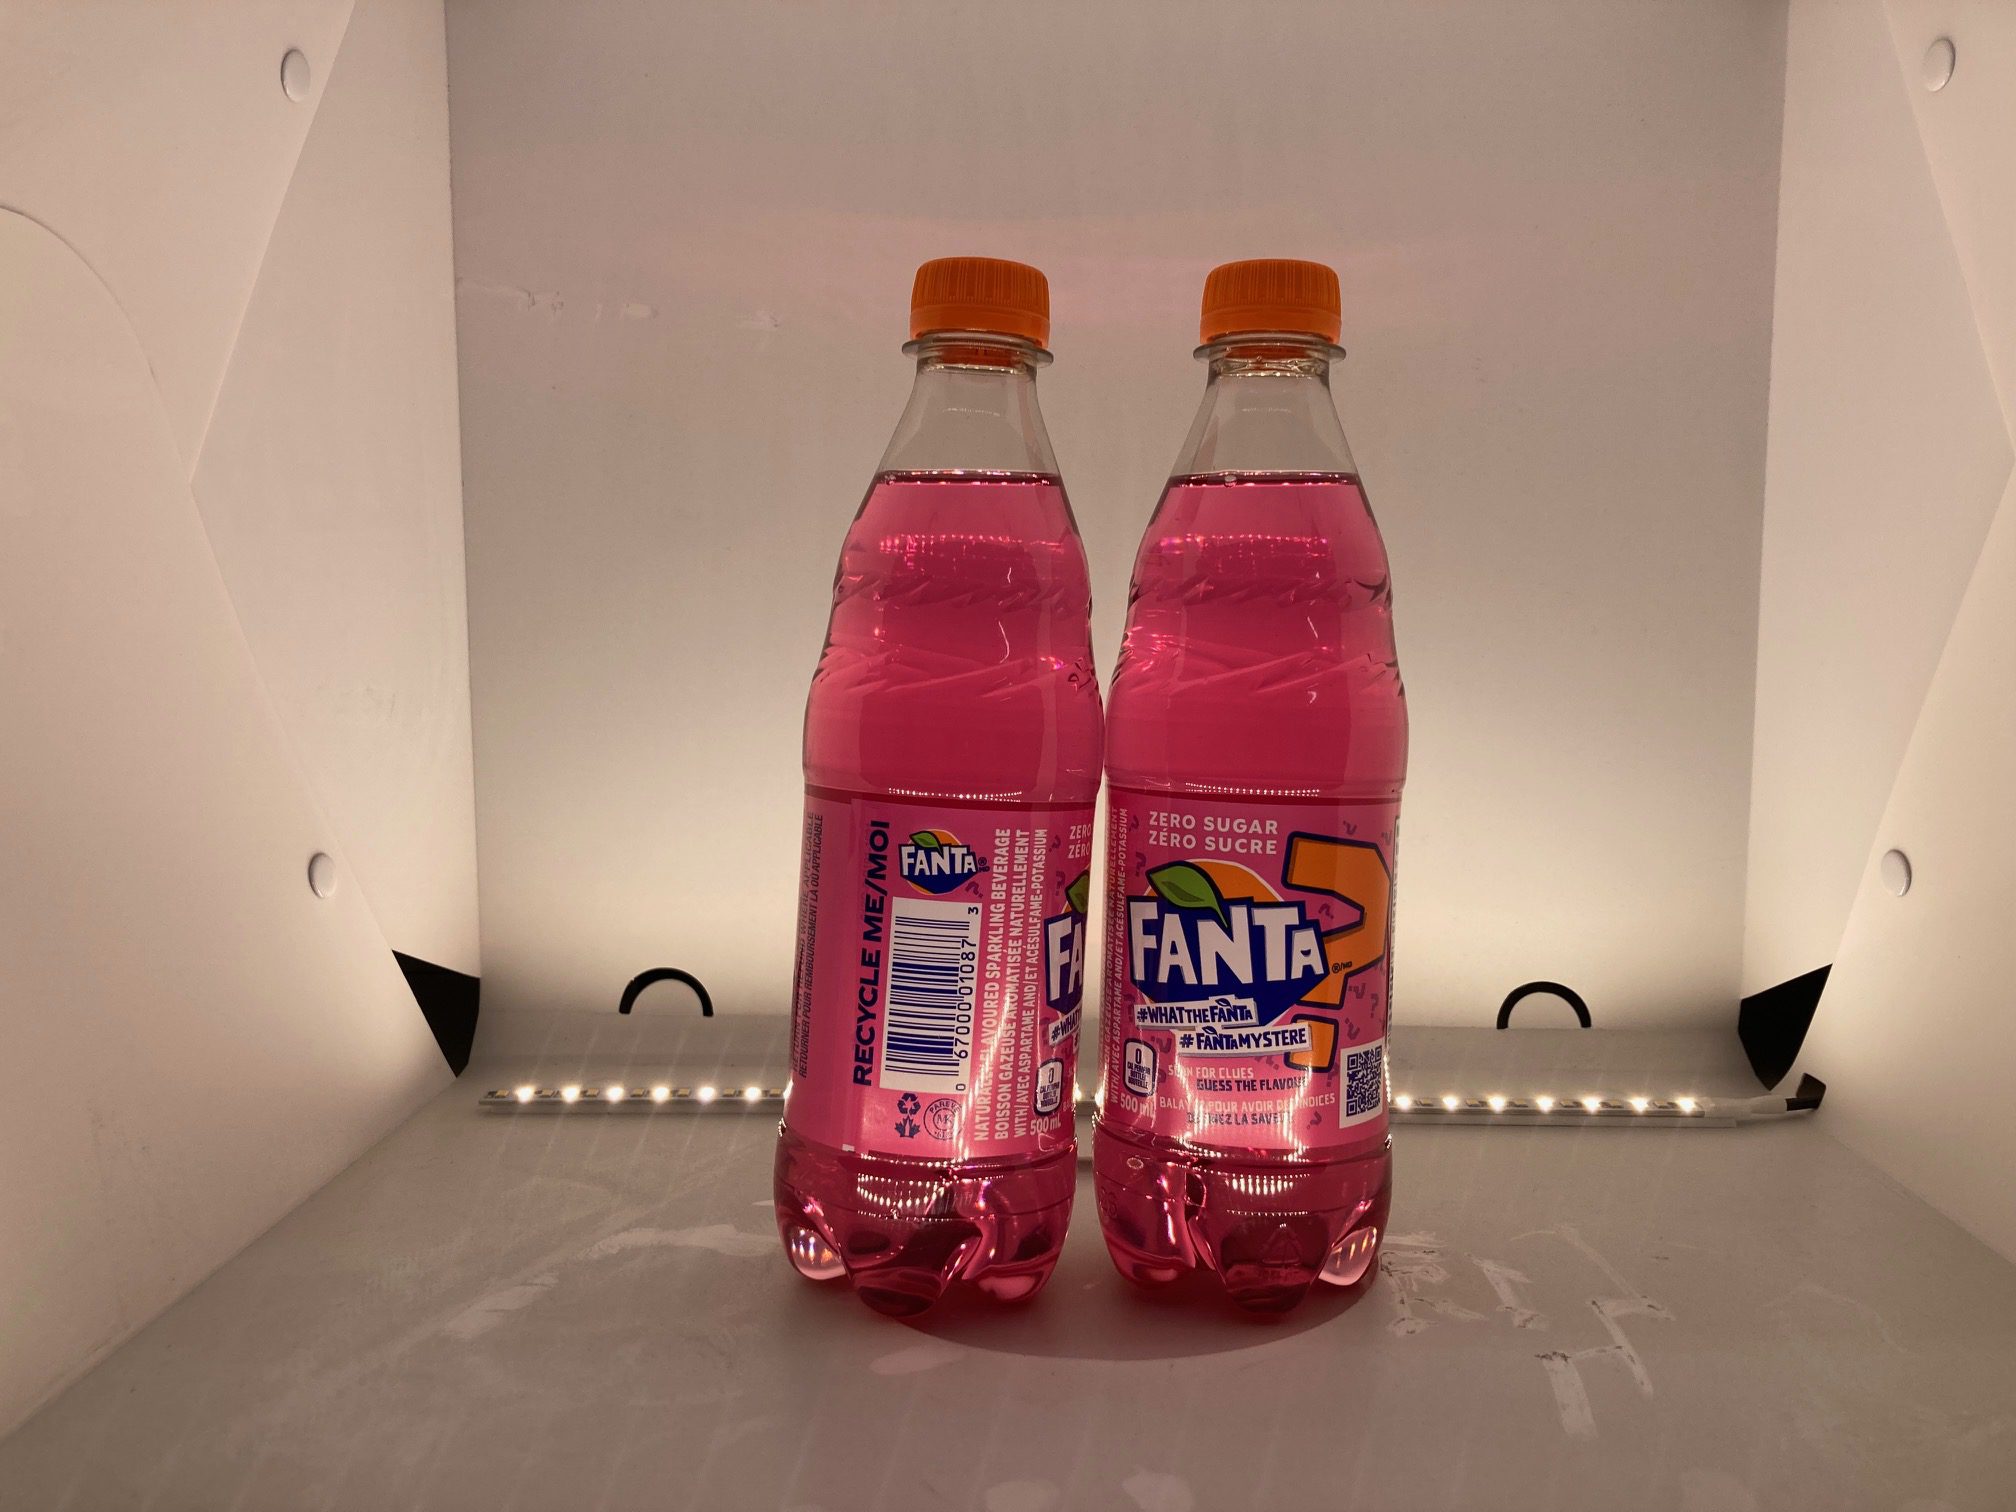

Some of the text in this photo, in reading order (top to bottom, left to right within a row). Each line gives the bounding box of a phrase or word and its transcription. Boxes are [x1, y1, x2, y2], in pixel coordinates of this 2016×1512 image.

[811, 813, 823, 873] APPLICABLE
[1069, 824, 1092, 840] ZERO
[1148, 828, 1278, 855] ZÉRO SUCRE
[1149, 811, 1278, 835] ZERO SUGAR
[901, 845, 977, 876] FANTA
[991, 828, 1011, 900] BEVERAGE
[1114, 808, 1128, 939] ACÉSULFAME-POTASSIUM
[1022, 828, 1048, 964] ACÉSULFAME-POTASSIUM
[804, 904, 818, 991] REMBOURSEMENT
[853, 820, 890, 1087] RECYCLE ME/MOI
[985, 903, 1006, 979] SPARKLING
[1129, 901, 1325, 986] FANTA
[802, 992, 812, 1019] POUR
[994, 829, 1030, 1140] BOISSON GAZEUSE AROMATISÉE NATURELLEMENT
[1112, 982, 1123, 1044] ASPARTAME
[798, 1020, 810, 1078] RETOURNER
[1017, 1008, 1035, 1073] ASPARTAME
[1168, 1064, 1255, 1079] SN FOR CLUES
[1196, 1079, 1233, 1092] GUESS
[1235, 1079, 1258, 1092] THE
[1030, 1118, 1049, 1136] 500
[1121, 1093, 1138, 1113] 500
[1159, 1096, 1205, 1112] BALAY
[1208, 1101, 1238, 1112] POUR
[1241, 1101, 1275, 1113] AVOIR
[1187, 1112, 1292, 1126] DINEZ LA SAVE
